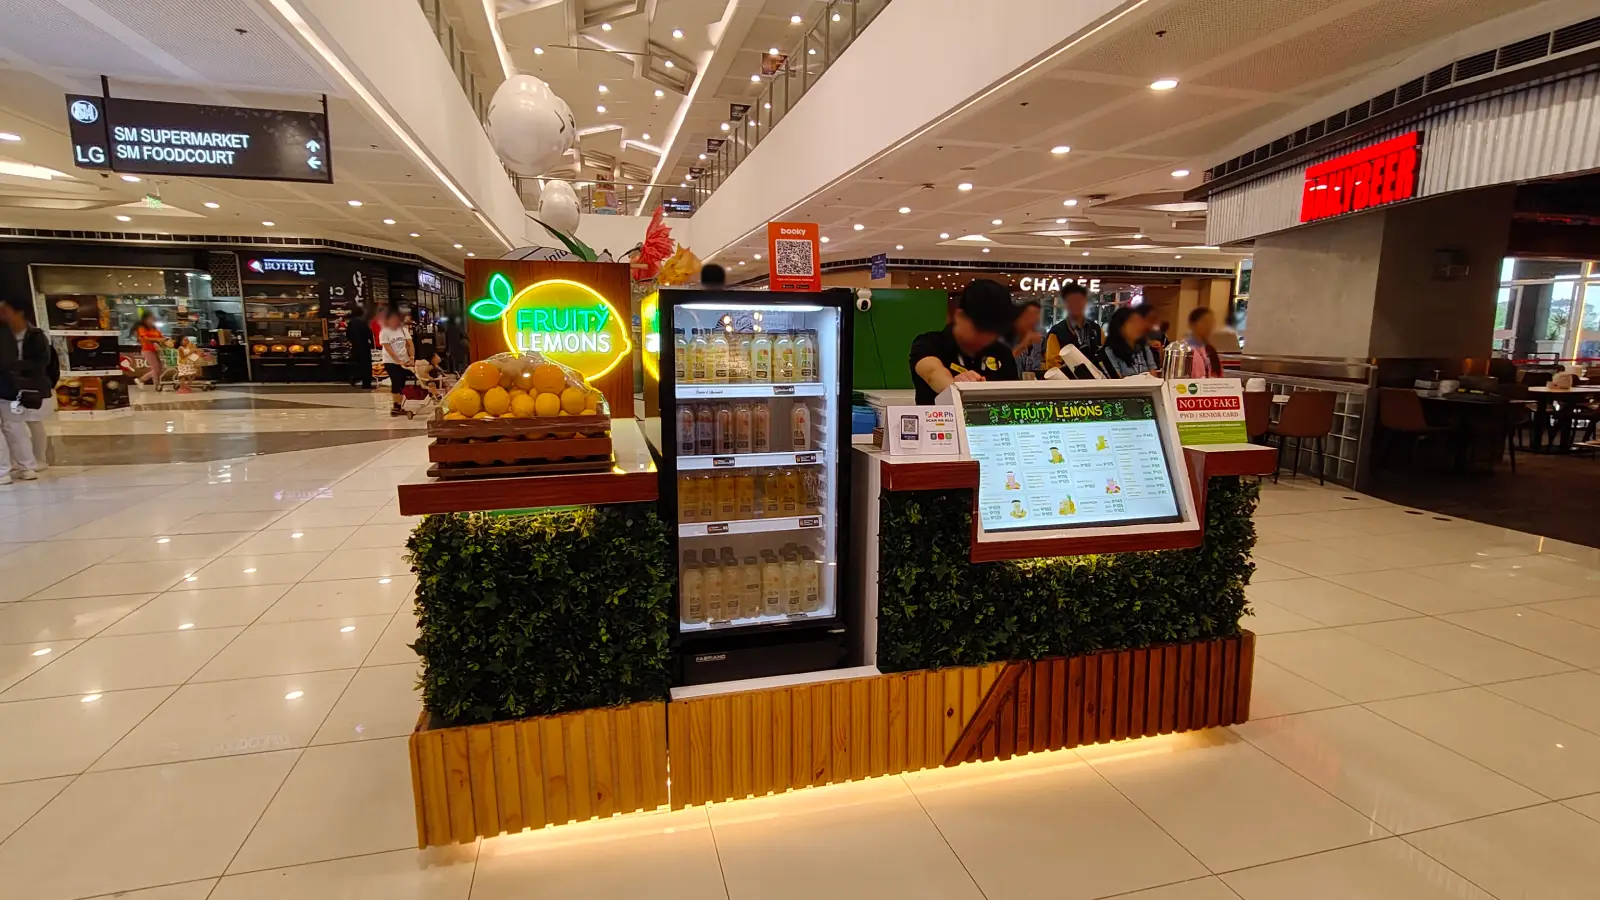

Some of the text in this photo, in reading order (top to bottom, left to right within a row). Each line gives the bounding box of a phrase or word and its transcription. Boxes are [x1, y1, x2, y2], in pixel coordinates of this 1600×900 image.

[72, 101, 97, 122] SM
[114, 127, 249, 149] SM SUPERMARKET
[76, 145, 105, 163] LG
[117, 145, 235, 165] SM FOODCOURT
[780, 228, 806, 236] booky
[264, 262, 315, 271] BOTEJYU
[517, 304, 609, 332] FRUITY
[517, 332, 611, 353] LEMONS
[1013, 405, 1103, 419] FRUITY LEMONS
[1179, 398, 1238, 408] NO TO FAKE
